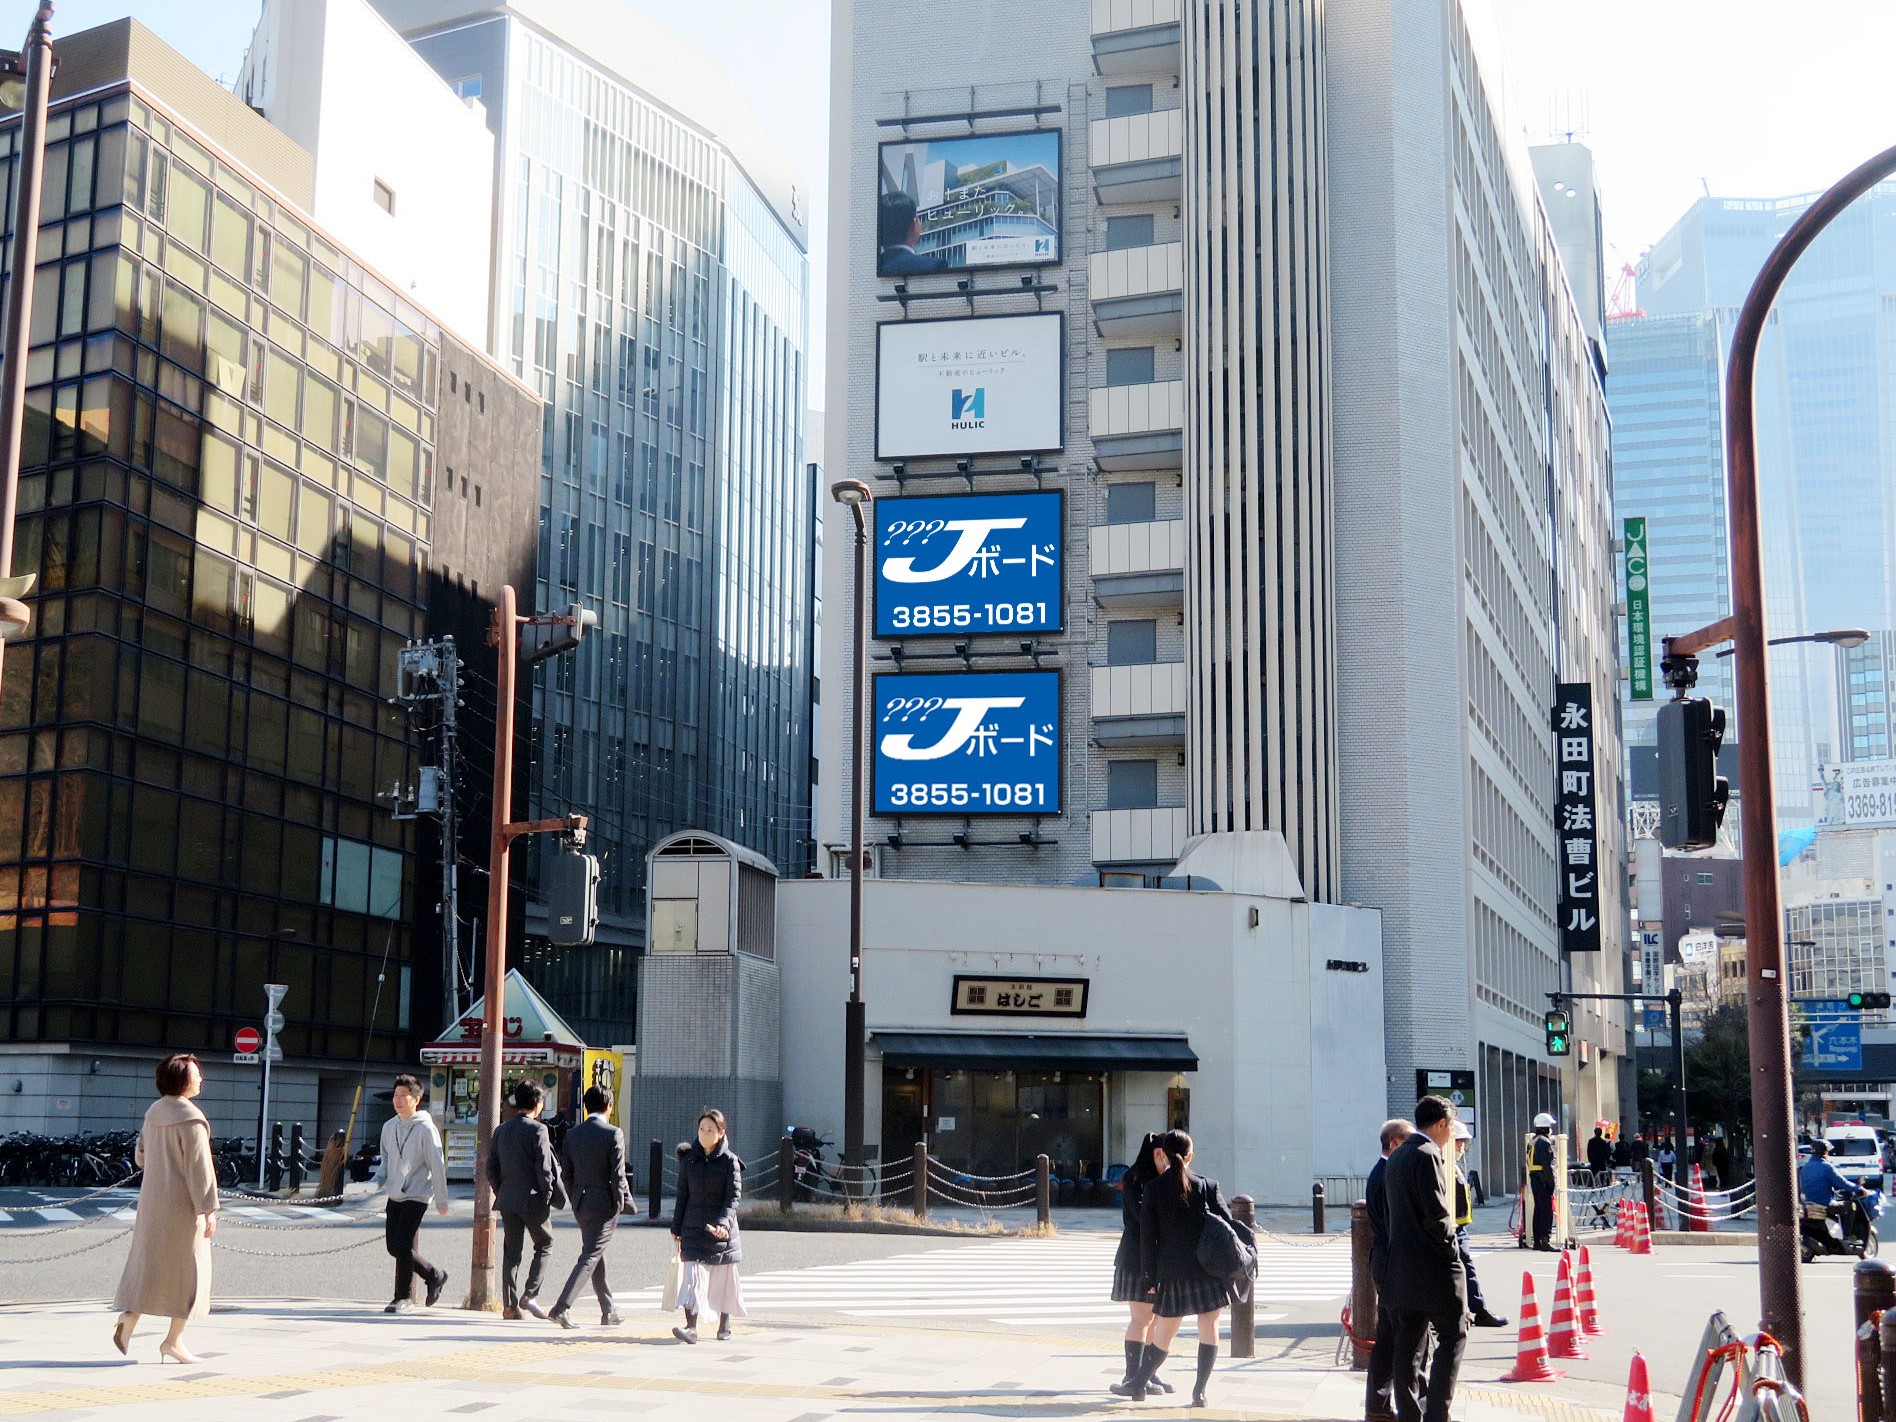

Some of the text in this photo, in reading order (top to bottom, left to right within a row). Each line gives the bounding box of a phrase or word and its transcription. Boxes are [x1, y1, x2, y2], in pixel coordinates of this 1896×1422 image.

[951, 421, 985, 430] HULIC
[892, 602, 1047, 628] 3855-1081
[1632, 600, 1647, 691] 日本環境認証機構
[890, 783, 1045, 806] 3855-1081
[1559, 701, 1597, 931] 永田町法曹ビル
[1643, 933, 1659, 945] ILC
[997, 993, 1043, 1008] はしご
[459, 1016, 524, 1039] 宝じ
[1828, 1036, 1858, 1045] 六本木
